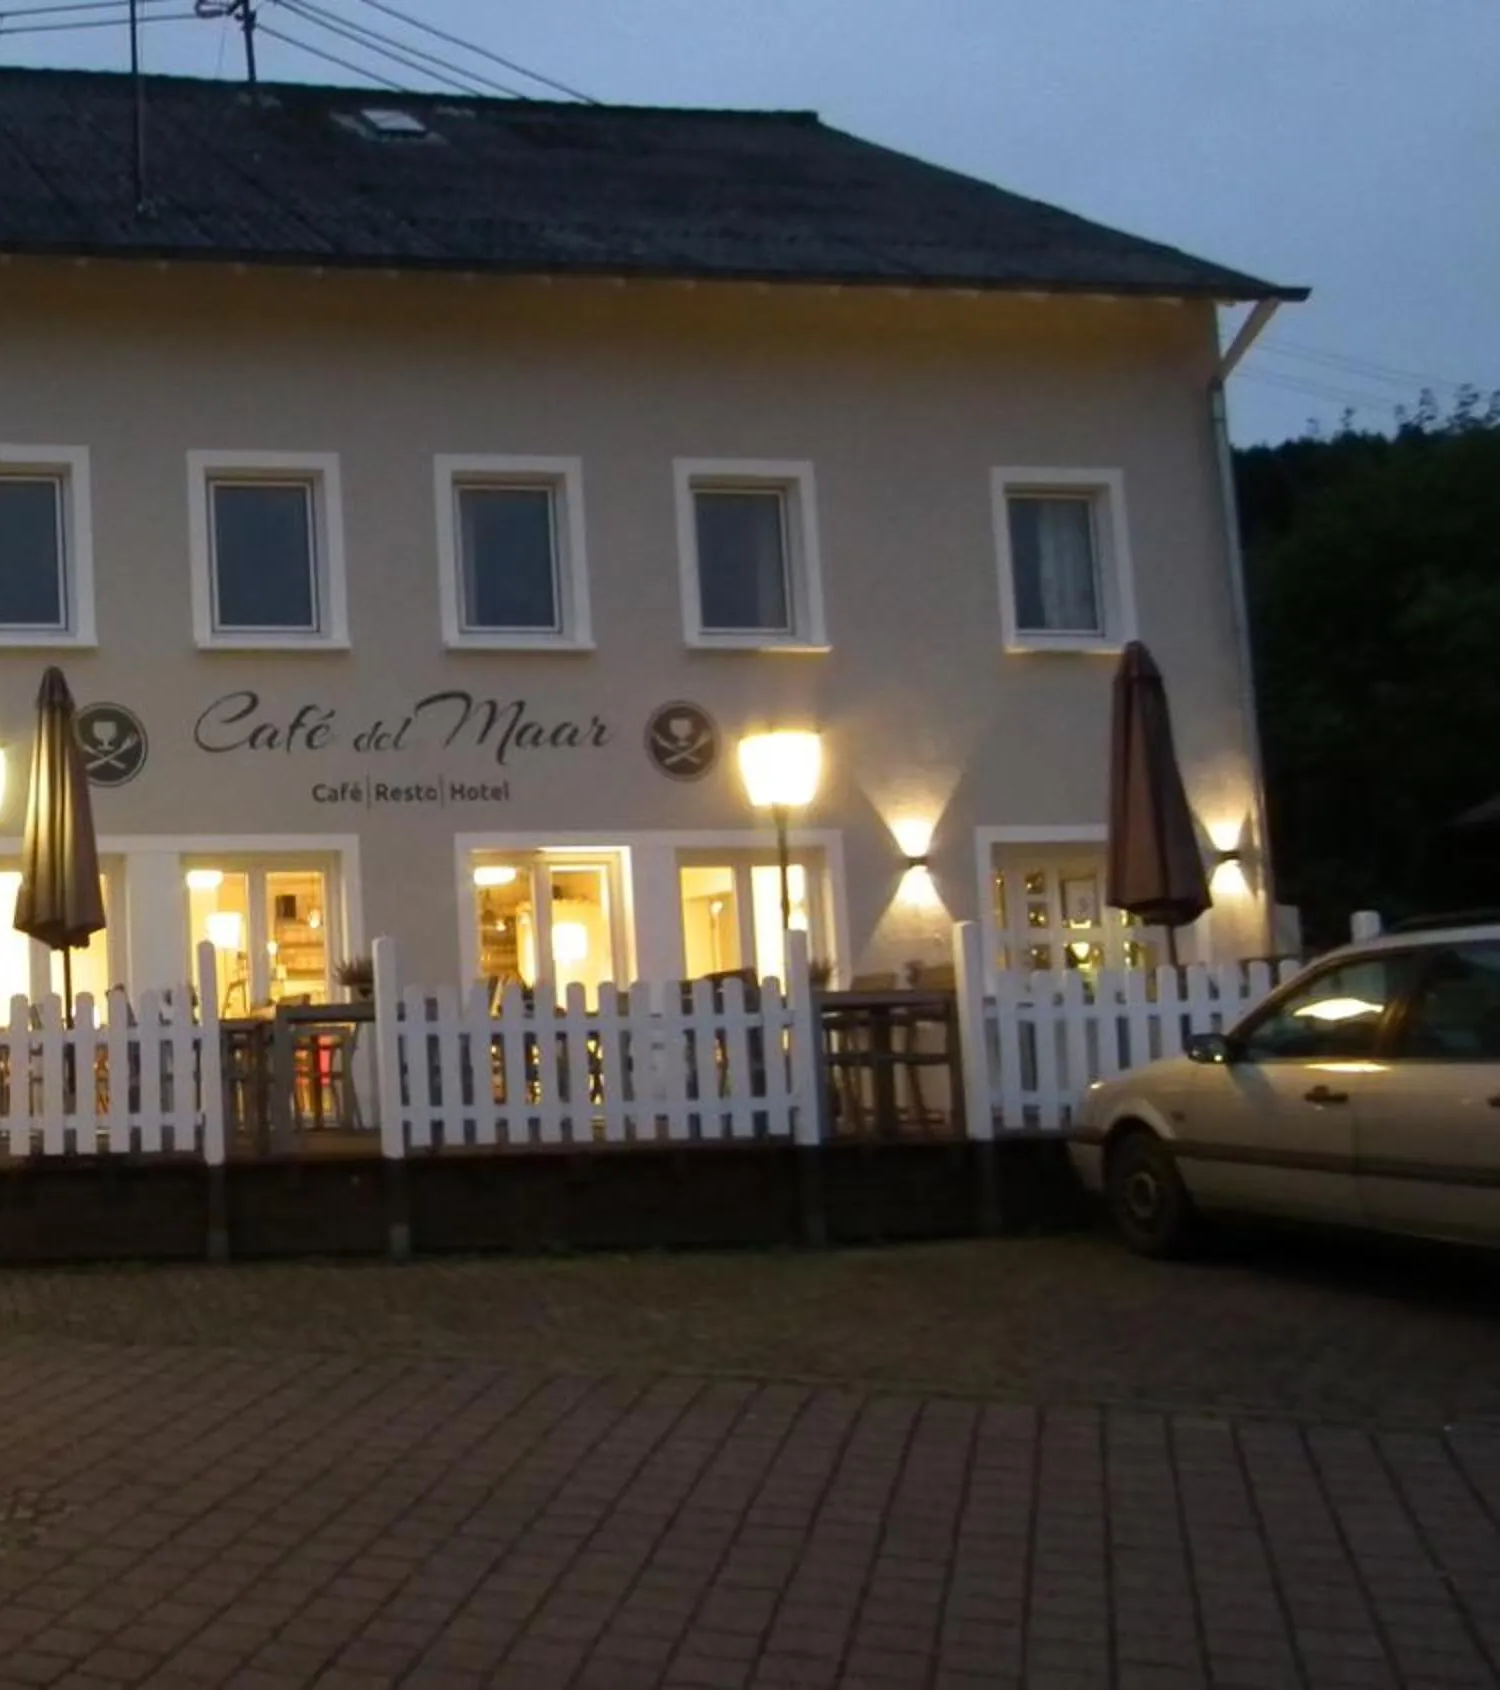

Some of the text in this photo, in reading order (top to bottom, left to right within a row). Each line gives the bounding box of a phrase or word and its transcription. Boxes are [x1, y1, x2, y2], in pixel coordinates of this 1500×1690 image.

[194, 690, 611, 766] Café del Maar
[311, 781, 510, 802] Café Resto Hotel
